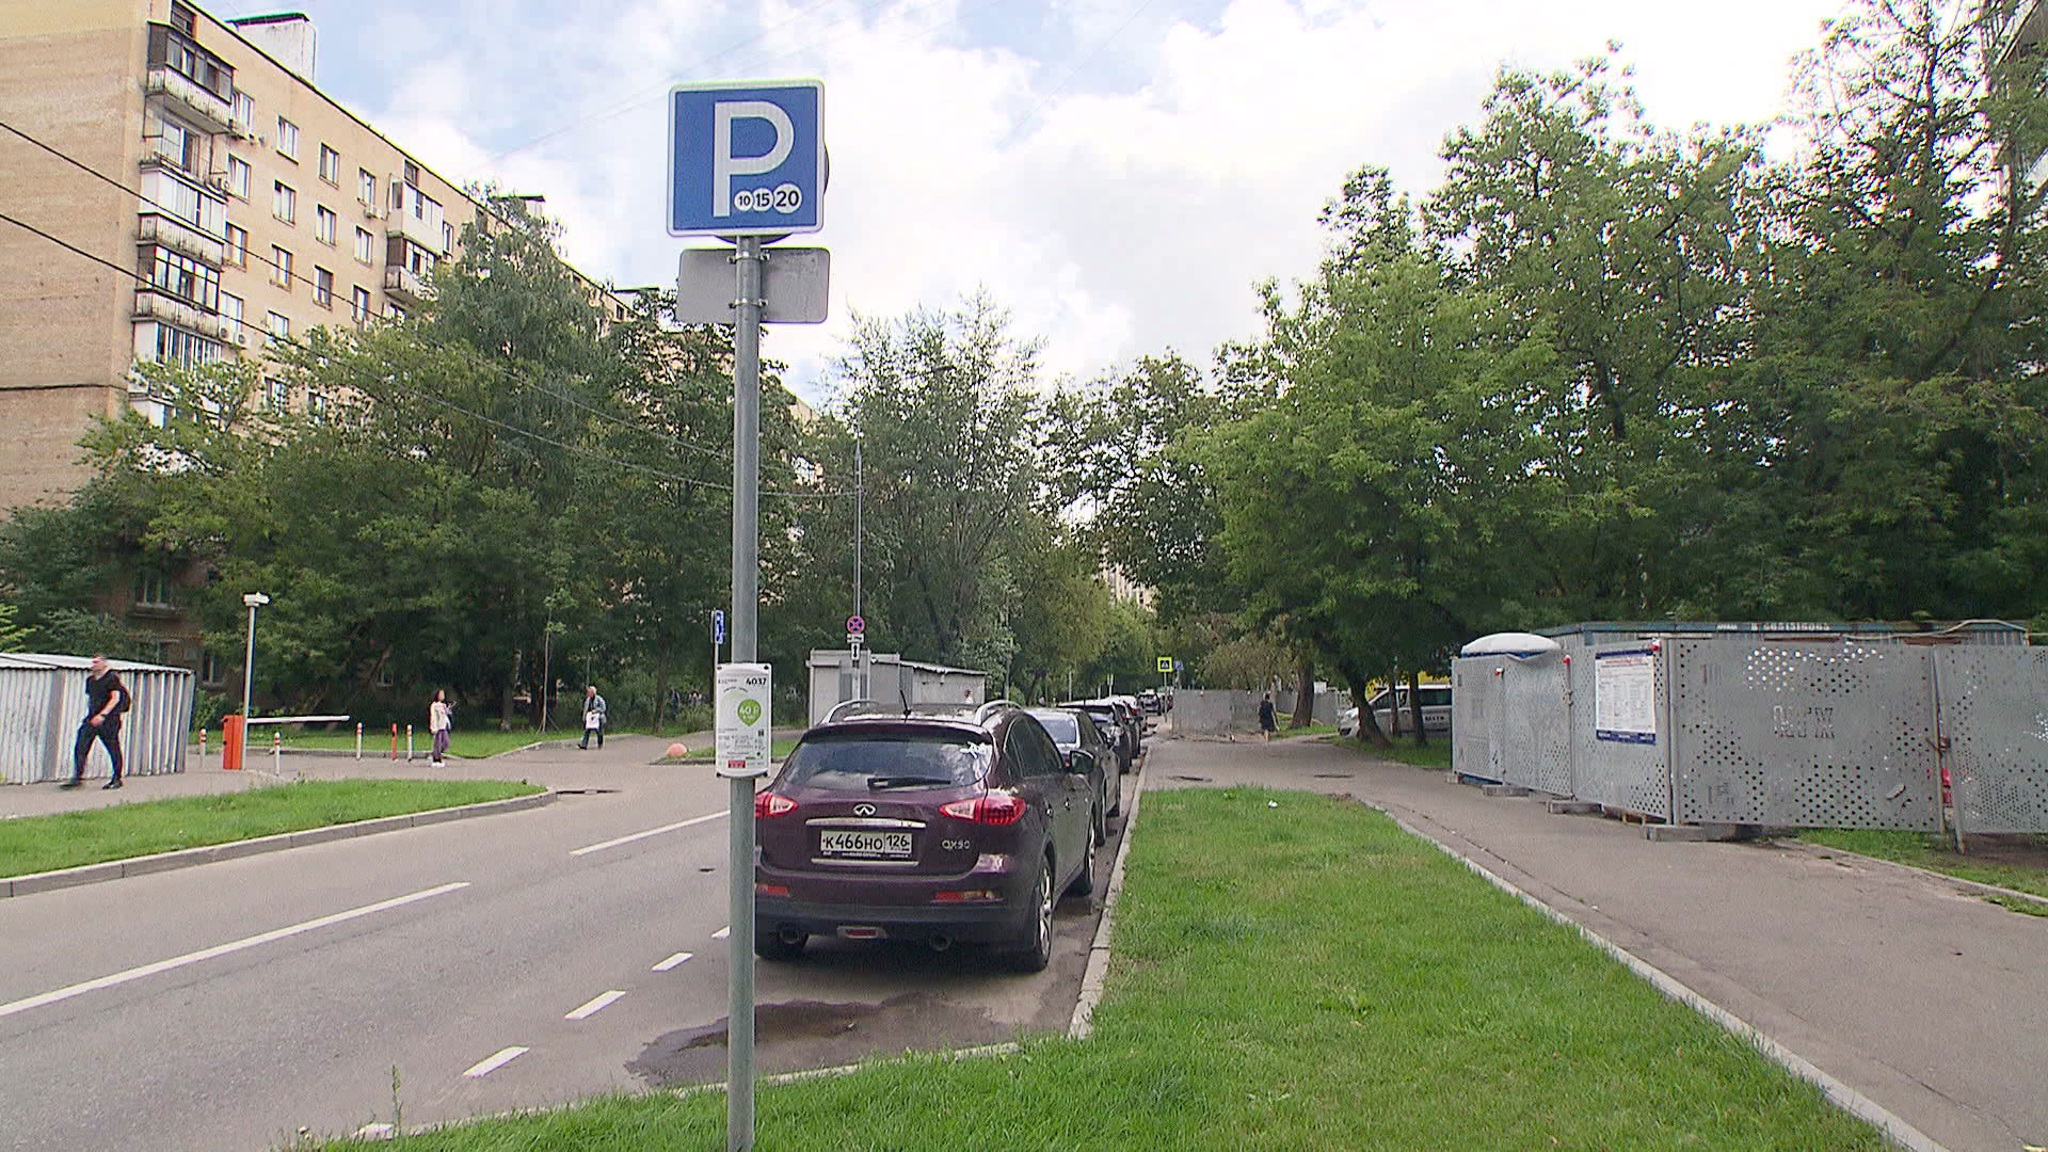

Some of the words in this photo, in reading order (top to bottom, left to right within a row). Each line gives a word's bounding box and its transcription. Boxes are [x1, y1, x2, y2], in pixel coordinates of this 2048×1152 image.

[713, 101, 795, 218] P
[739, 195, 751, 206] 10
[756, 193, 770, 207] 15
[776, 191, 799, 207] 20
[886, 834, 906, 847] 126
[941, 839, 971, 850] QX50
